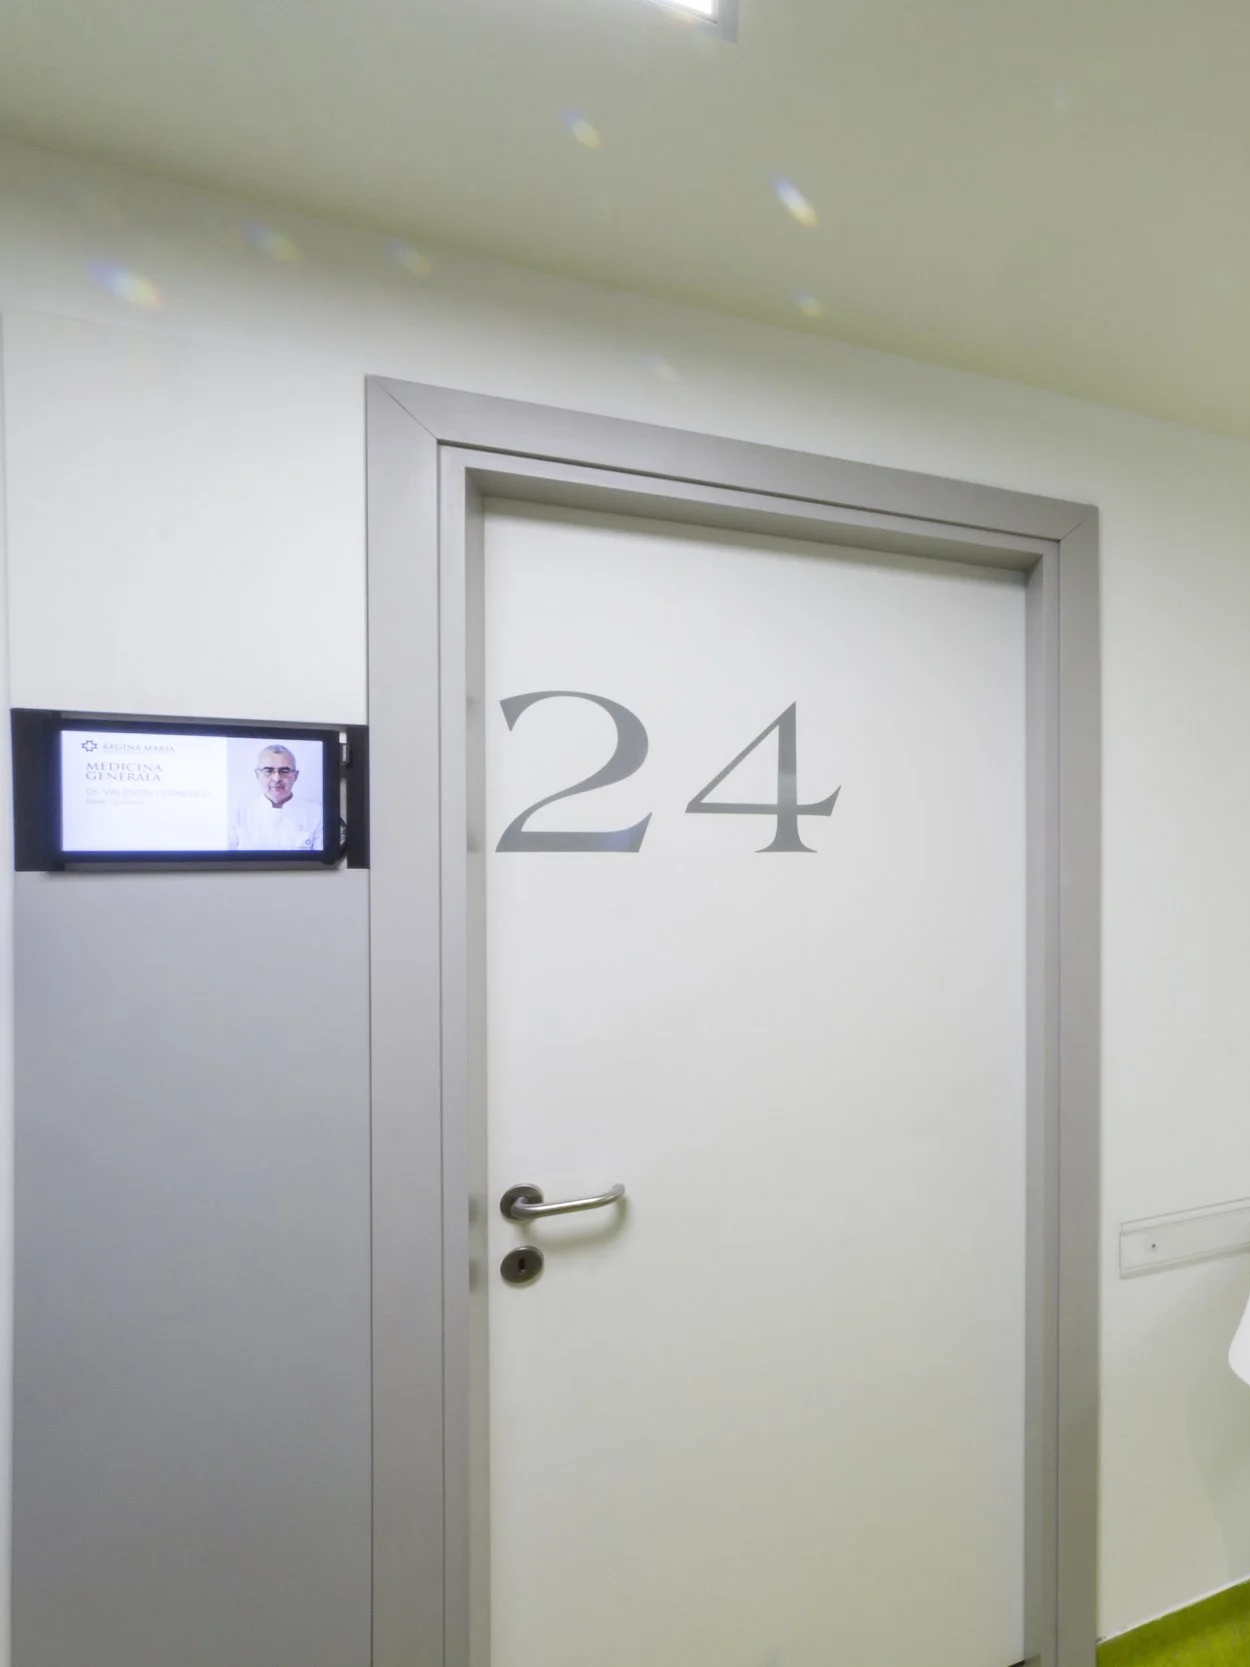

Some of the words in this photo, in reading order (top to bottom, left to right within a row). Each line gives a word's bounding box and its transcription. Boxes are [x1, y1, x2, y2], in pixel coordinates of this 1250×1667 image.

[102, 742, 141, 751] REGINA
[144, 744, 176, 752] MARIA
[86, 762, 163, 772] MEDICINA
[496, 690, 842, 854] 24
